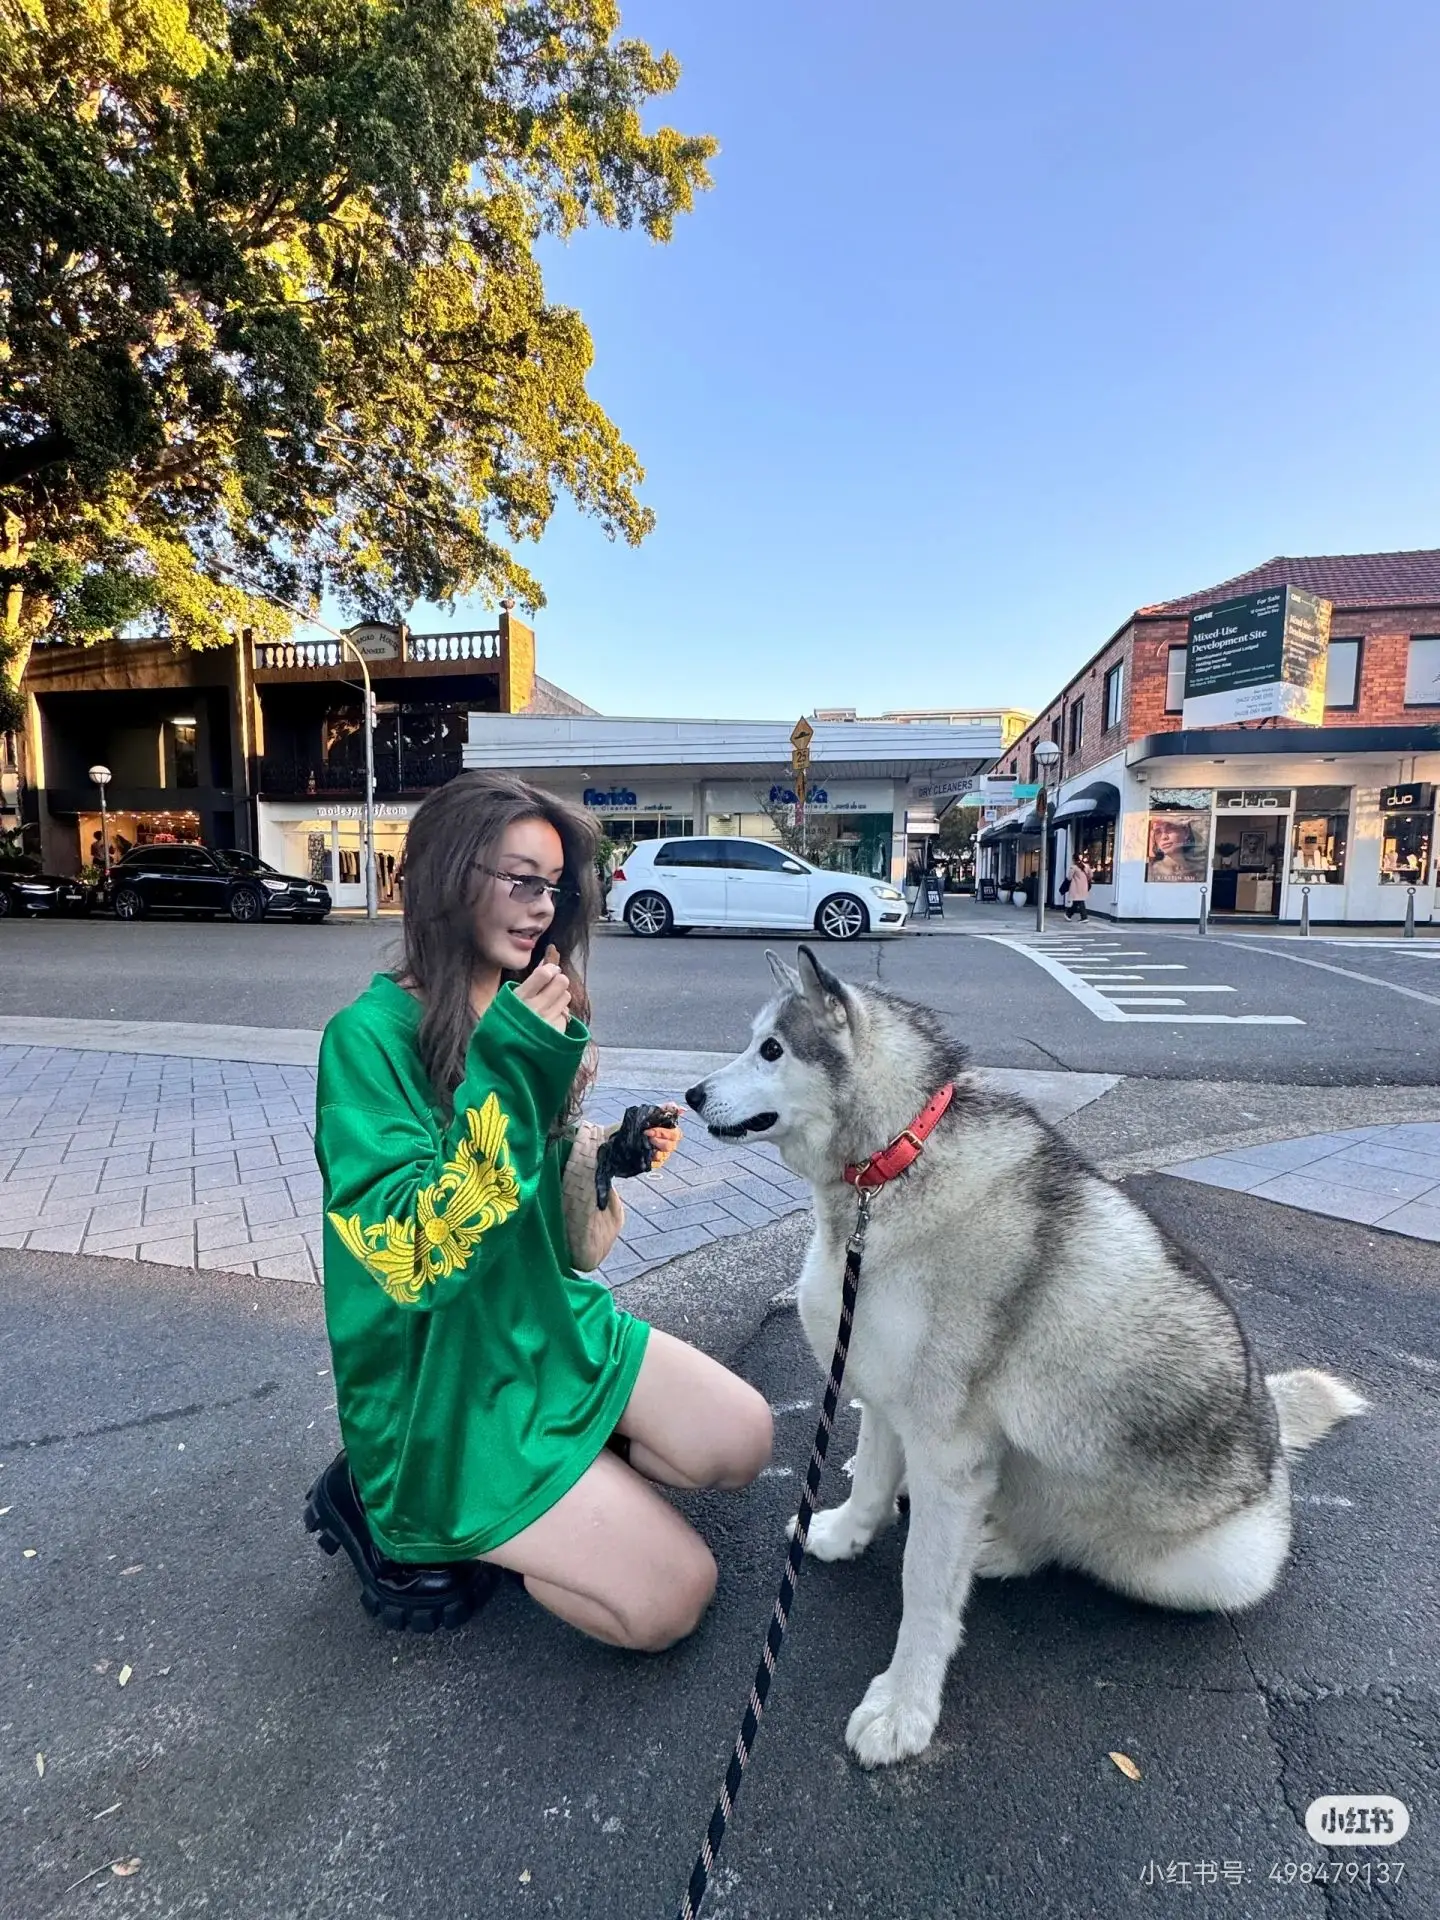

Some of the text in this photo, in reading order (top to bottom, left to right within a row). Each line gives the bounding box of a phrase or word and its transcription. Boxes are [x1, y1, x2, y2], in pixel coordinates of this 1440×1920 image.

[1256, 594, 1281, 606] For Sale
[1191, 629, 1268, 654] Development Site
[1192, 626, 1238, 644] Mixed-Use
[796, 751, 807, 761] 25
[918, 779, 973, 798] DRY CLEANERS
[1387, 788, 1413, 806] duo
[1227, 791, 1278, 808] duo
